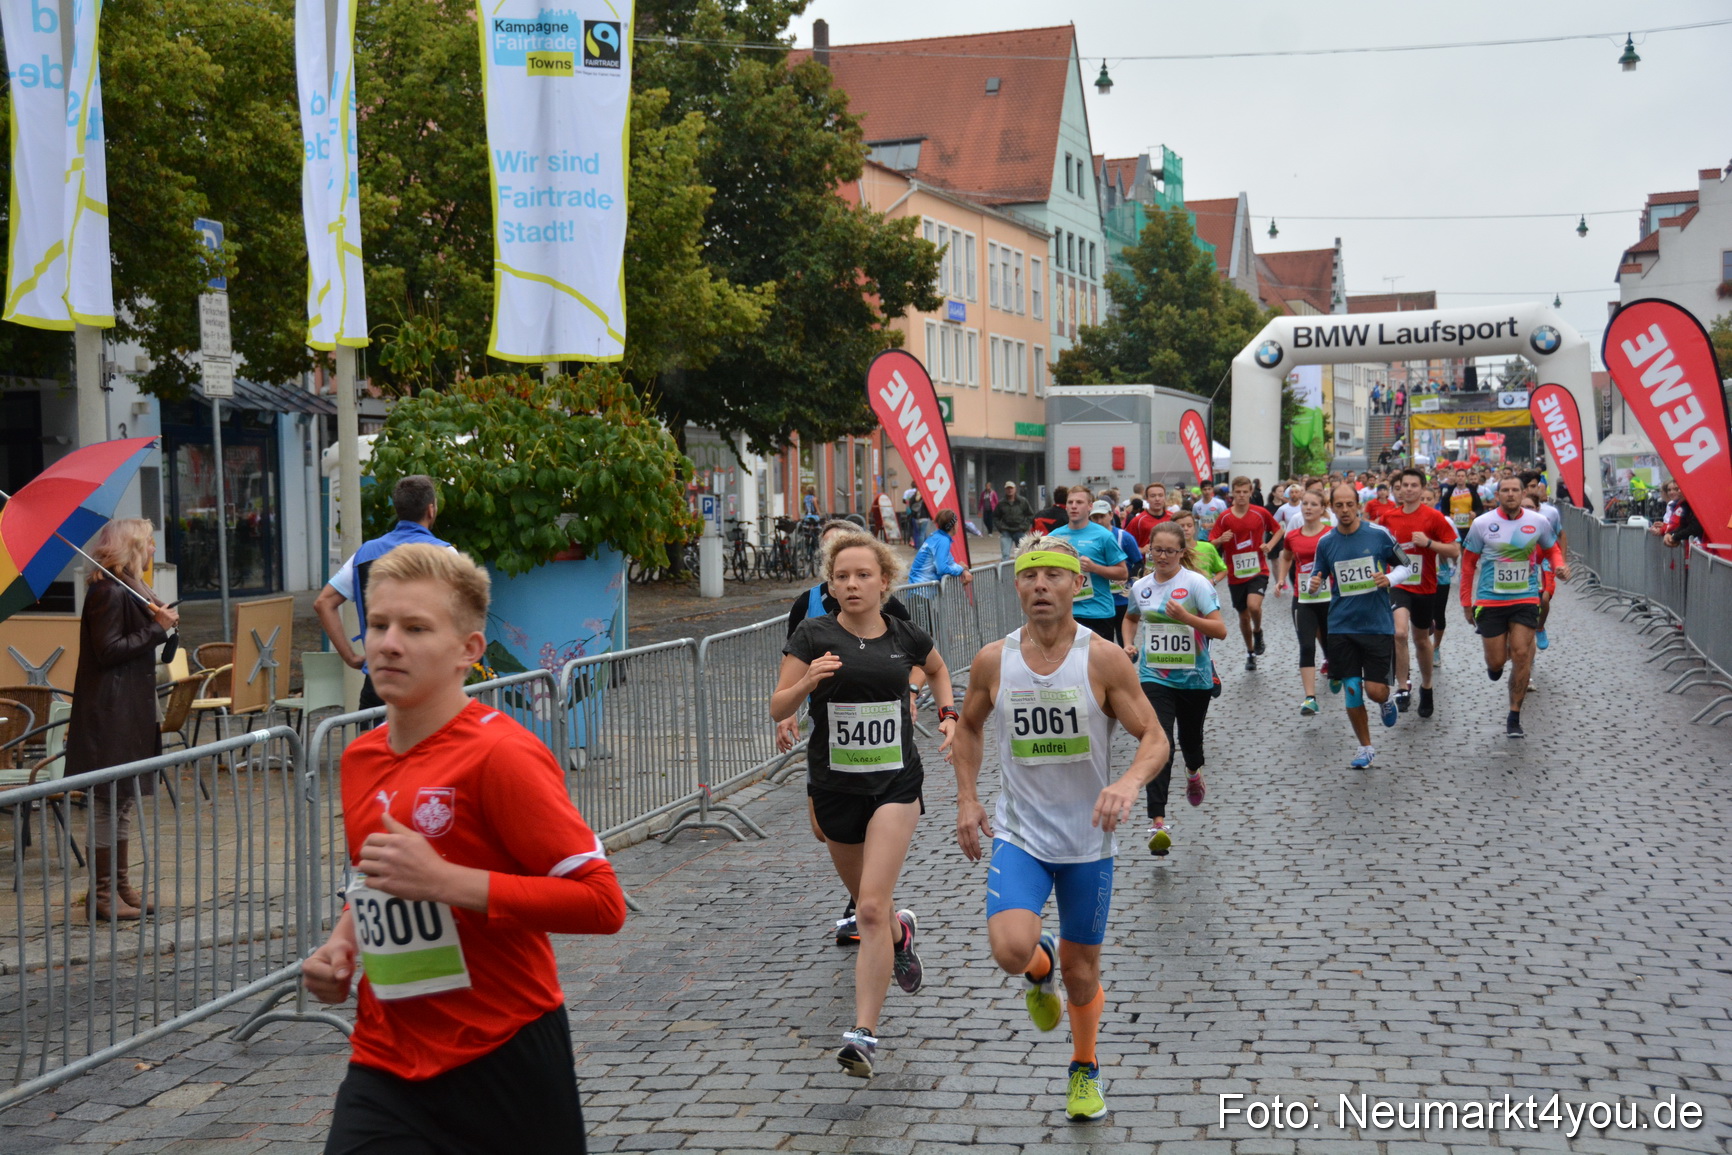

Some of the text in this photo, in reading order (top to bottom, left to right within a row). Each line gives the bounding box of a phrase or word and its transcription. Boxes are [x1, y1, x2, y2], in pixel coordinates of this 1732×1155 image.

[494, 20, 568, 35] Kampagne
[495, 34, 578, 50] Fairtrade
[528, 57, 572, 70] Towns
[585, 59, 620, 67] FAIRTRADE
[496, 150, 599, 174] Wir sind
[503, 220, 574, 244] Stadt!
[1293, 317, 1519, 348] BMW Laufsport
[1457, 415, 1484, 425] ZIEL
[705, 500, 712, 511] P
[1236, 558, 1256, 569] 5177
[1340, 566, 1372, 582] 5216
[1498, 569, 1526, 582] 5317
[1151, 635, 1190, 652] 5105
[1040, 690, 1077, 700] BOCK
[861, 704, 896, 714] BOCK
[1014, 706, 1079, 736] 5061
[837, 718, 896, 745] 5400
[1032, 742, 1067, 754] Andrei
[355, 897, 442, 947] 5300
